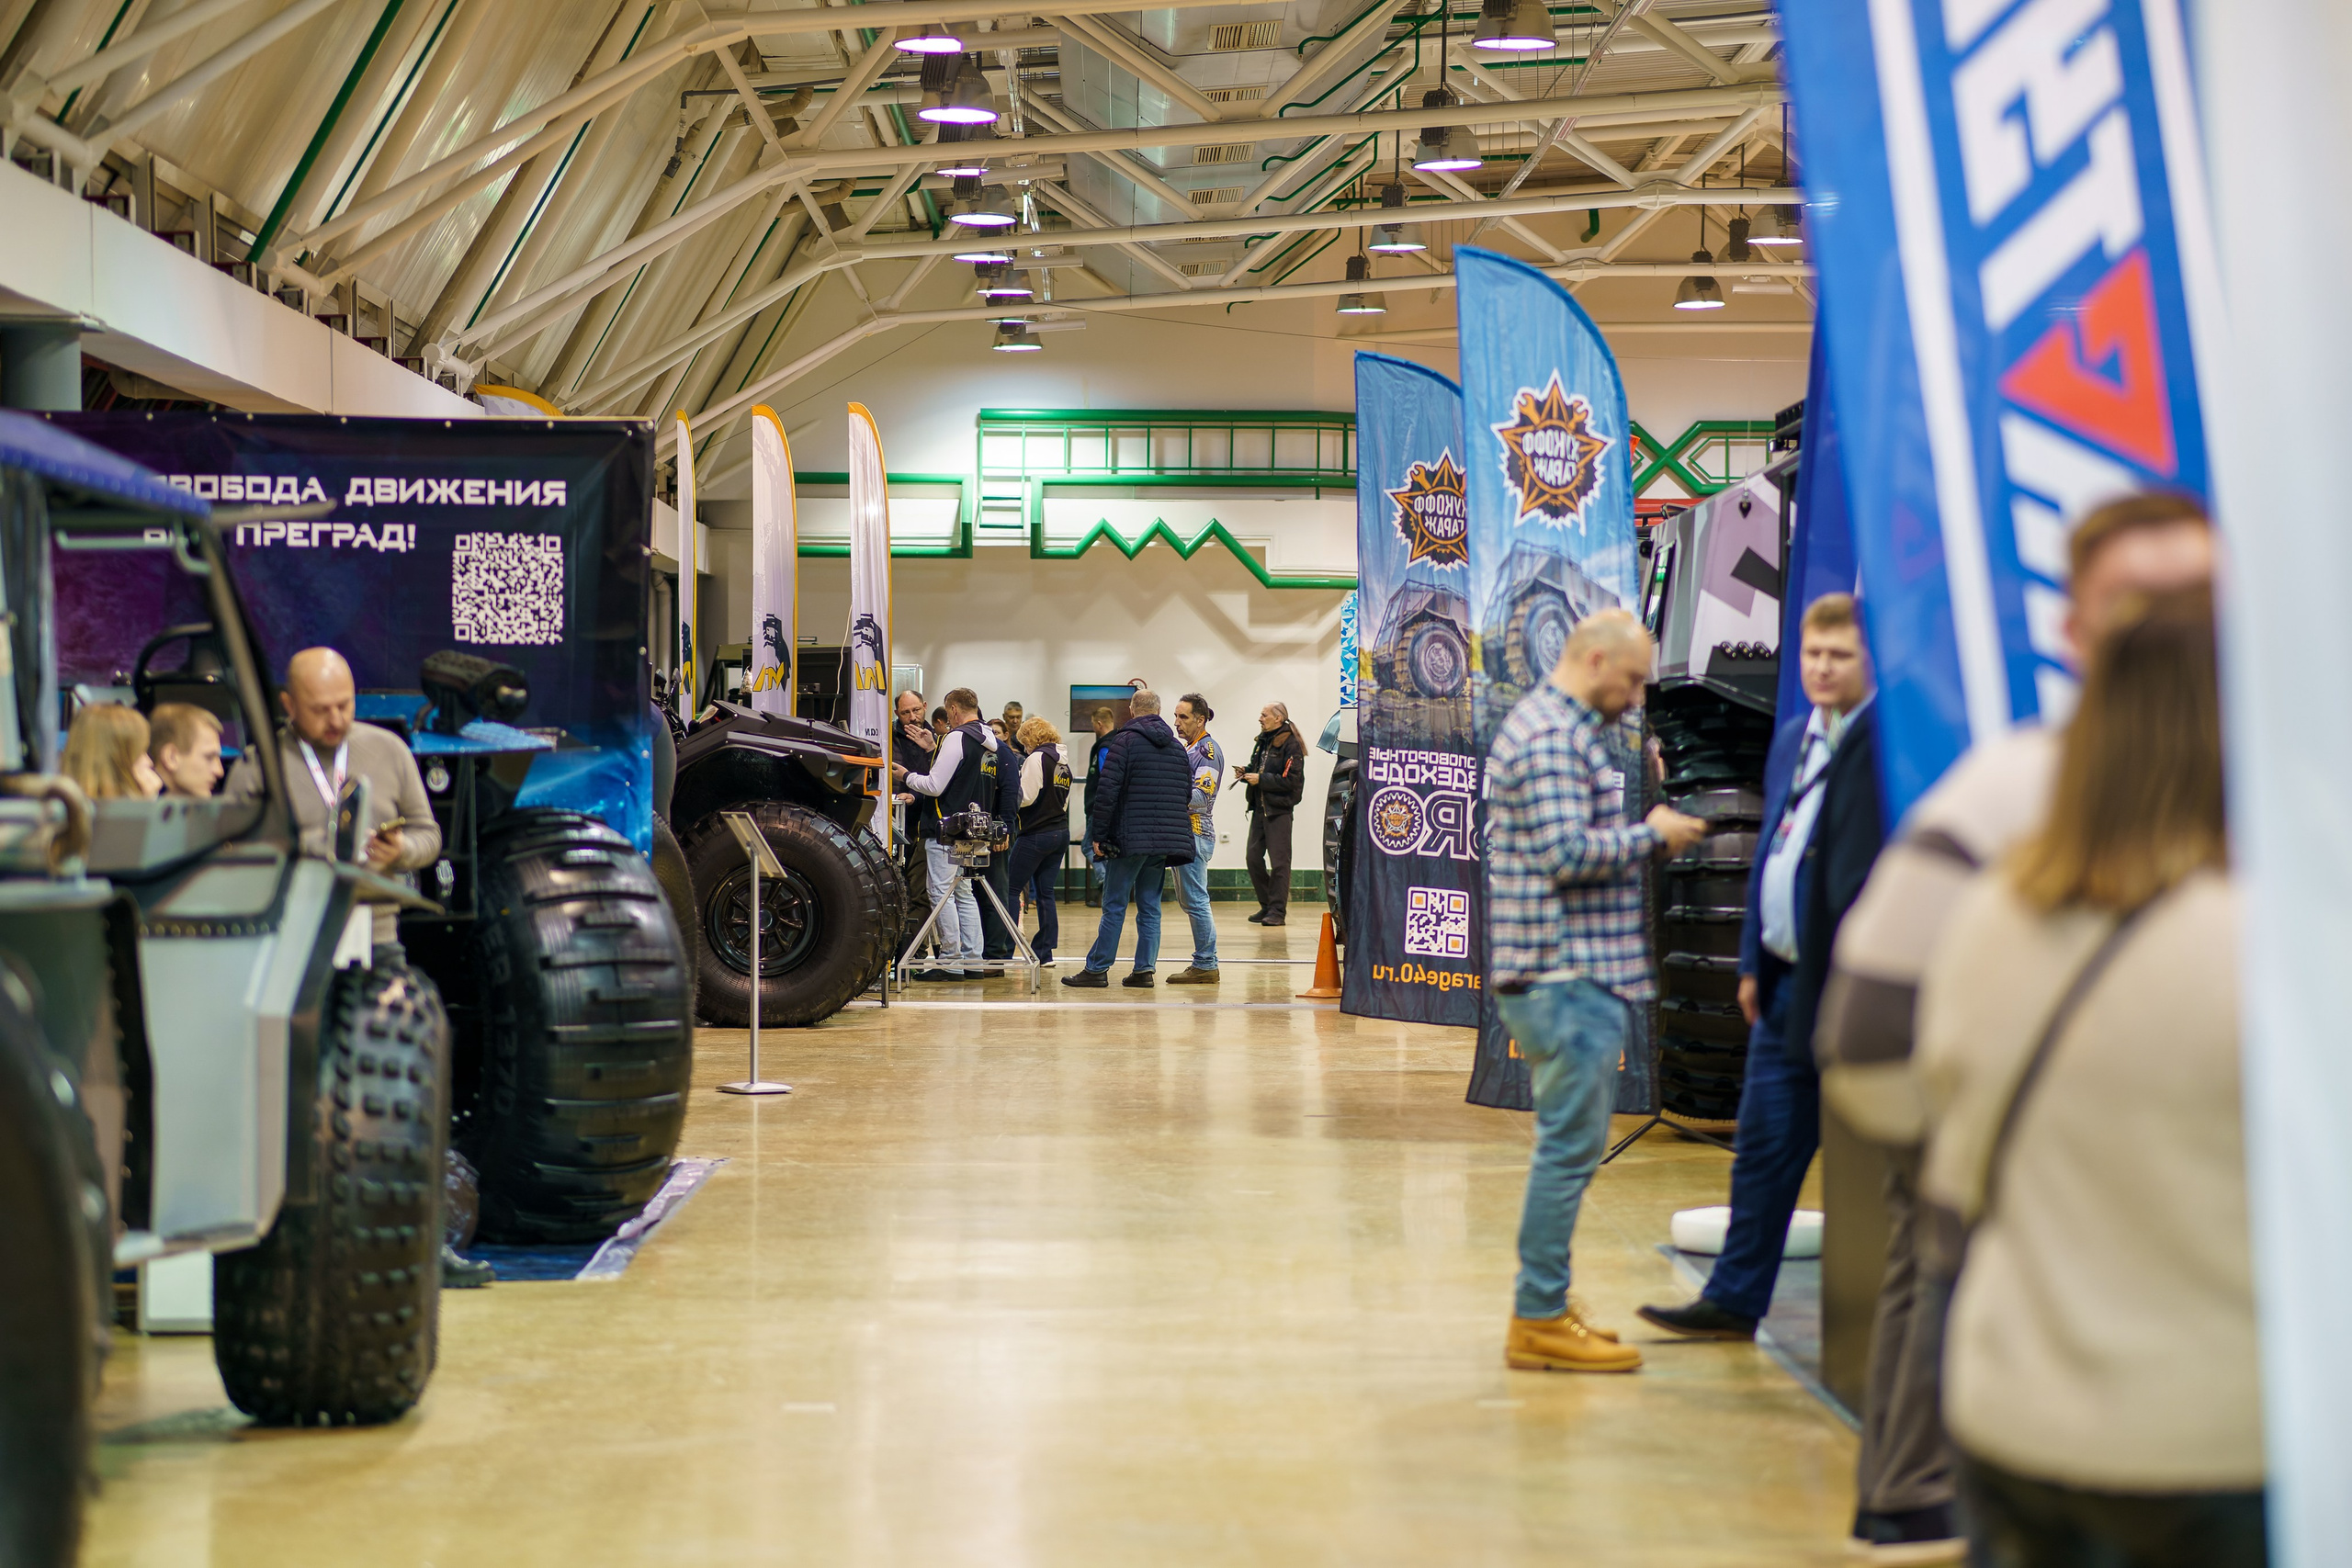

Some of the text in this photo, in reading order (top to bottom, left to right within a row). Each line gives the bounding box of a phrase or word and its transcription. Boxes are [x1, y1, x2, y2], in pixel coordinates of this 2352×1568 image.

[152, 474, 567, 507] ВОБОДА ДВИЖЕНИЯ
[236, 522, 416, 553] ПРЕГРАД!
